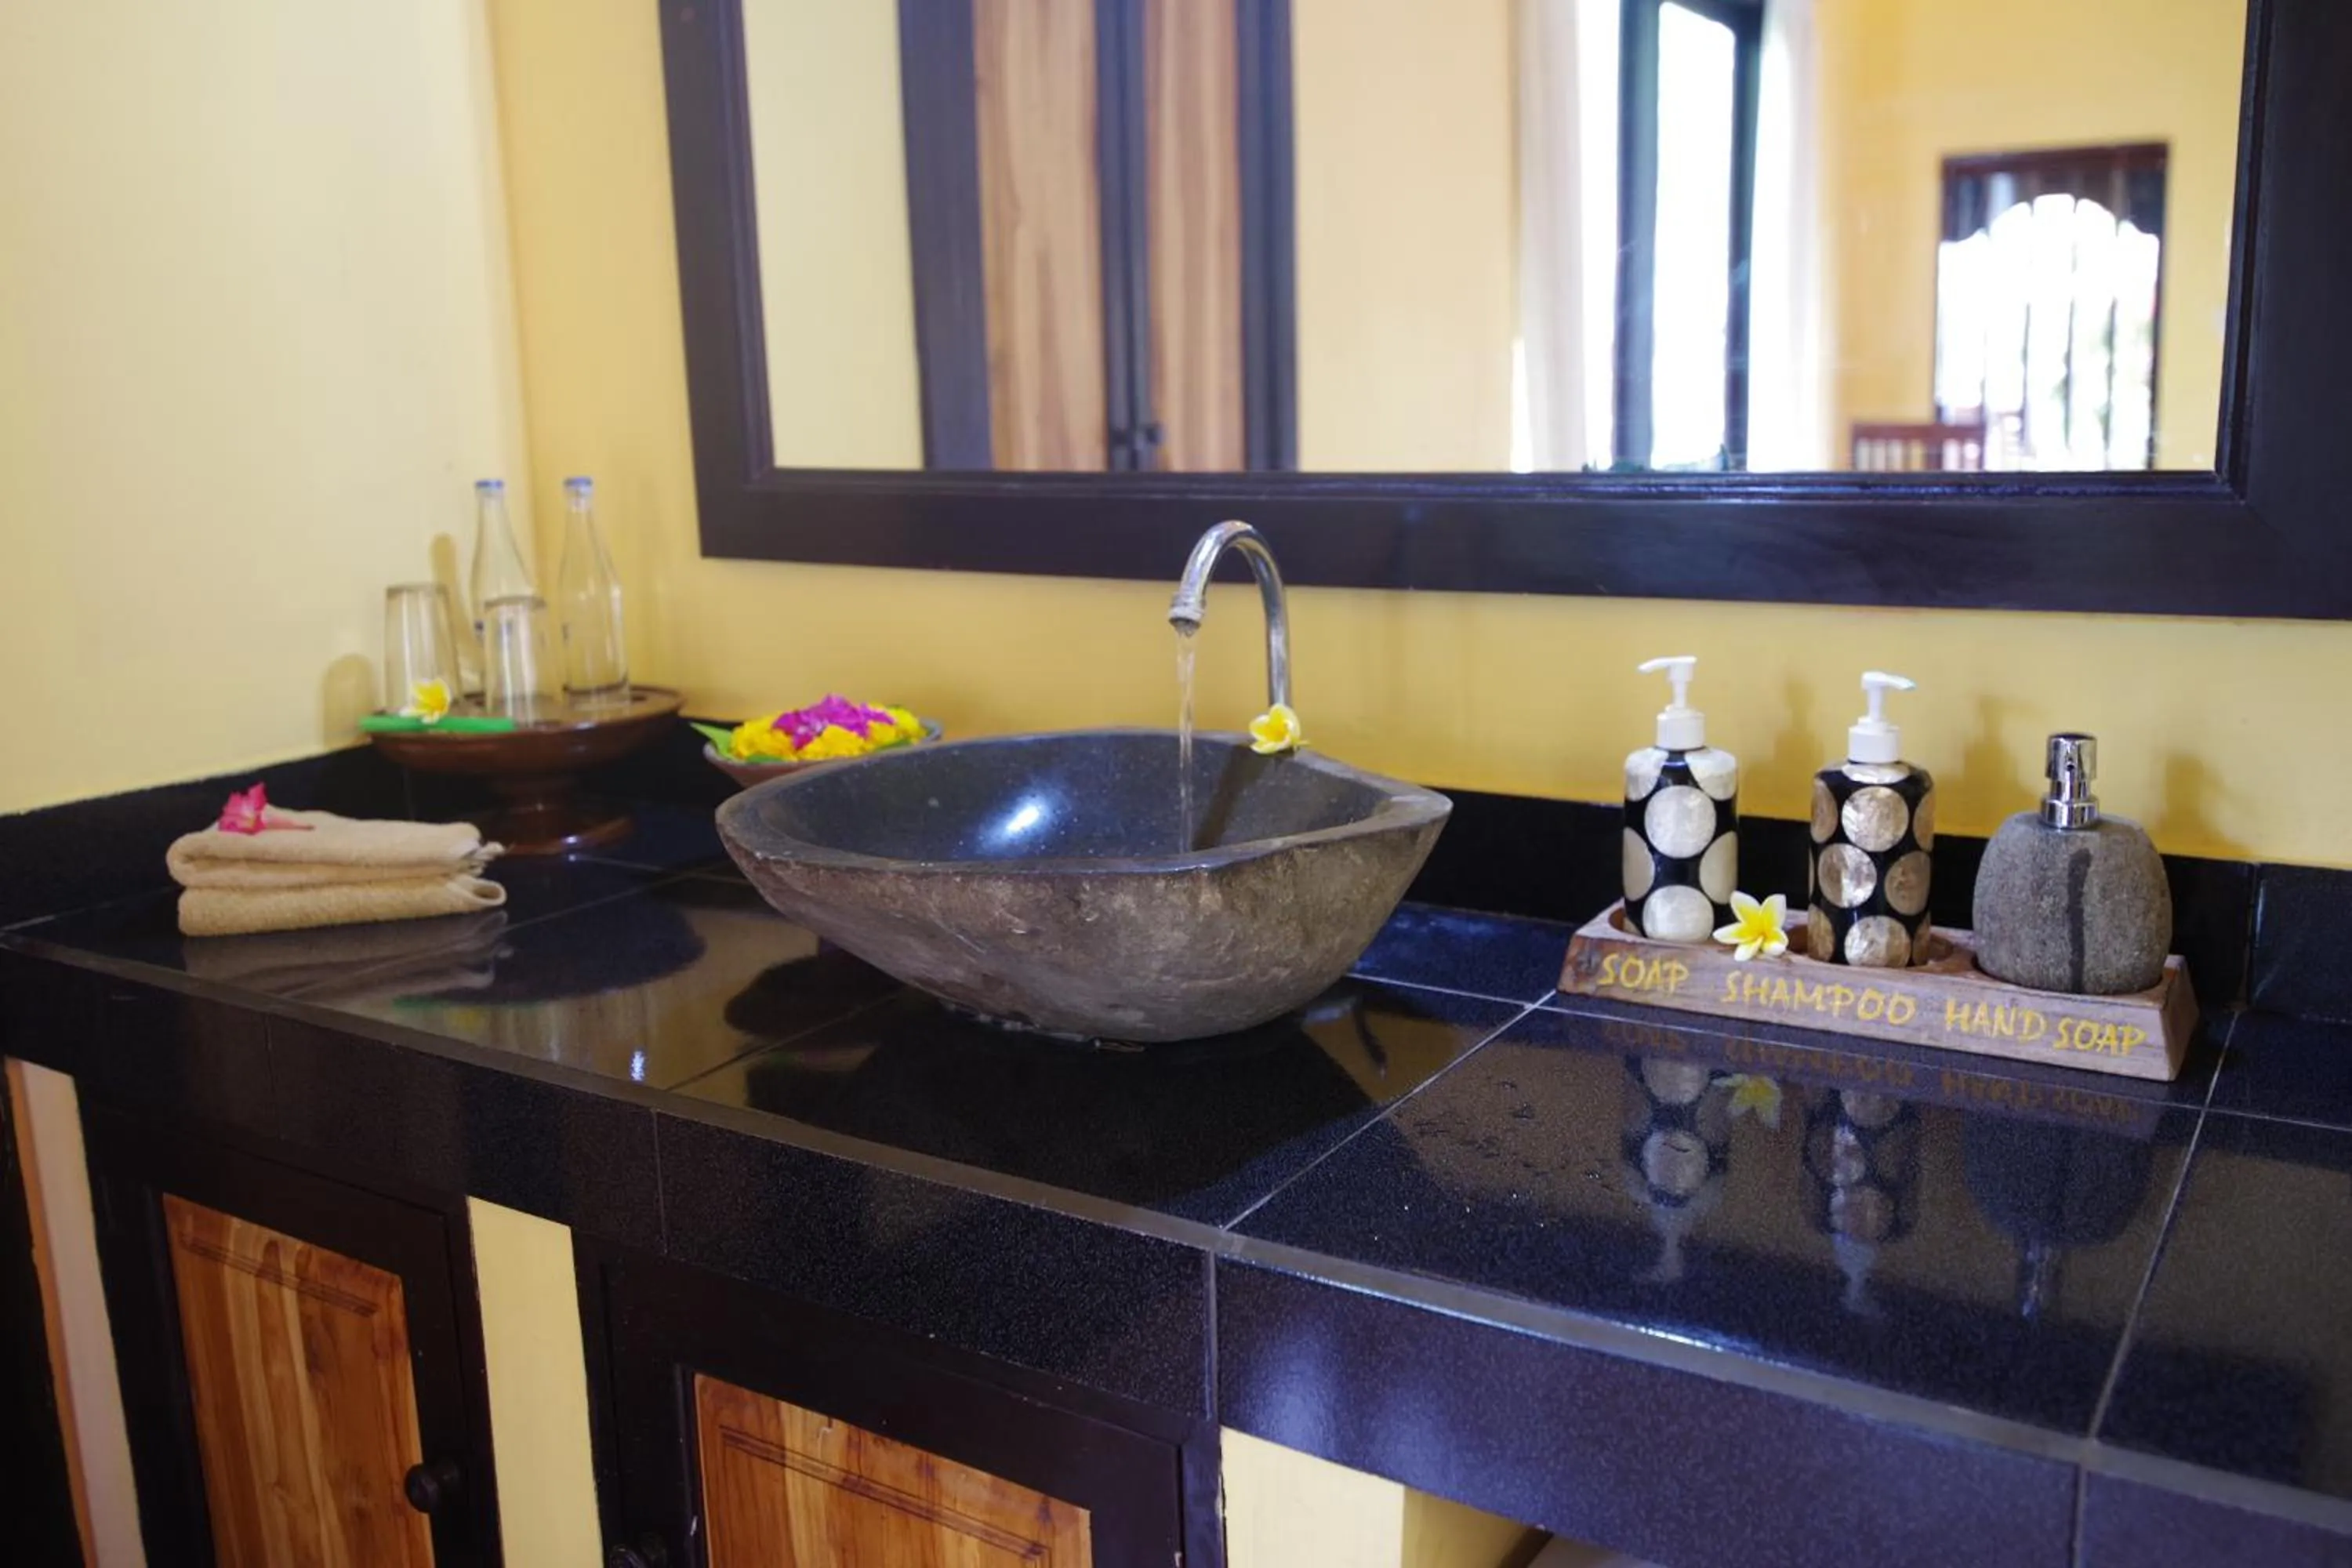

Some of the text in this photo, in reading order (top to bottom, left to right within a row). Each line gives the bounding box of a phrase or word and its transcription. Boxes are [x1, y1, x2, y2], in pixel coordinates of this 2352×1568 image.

[1598, 953, 2147, 1055] SOAP SHAMPOO HAND SOAP
